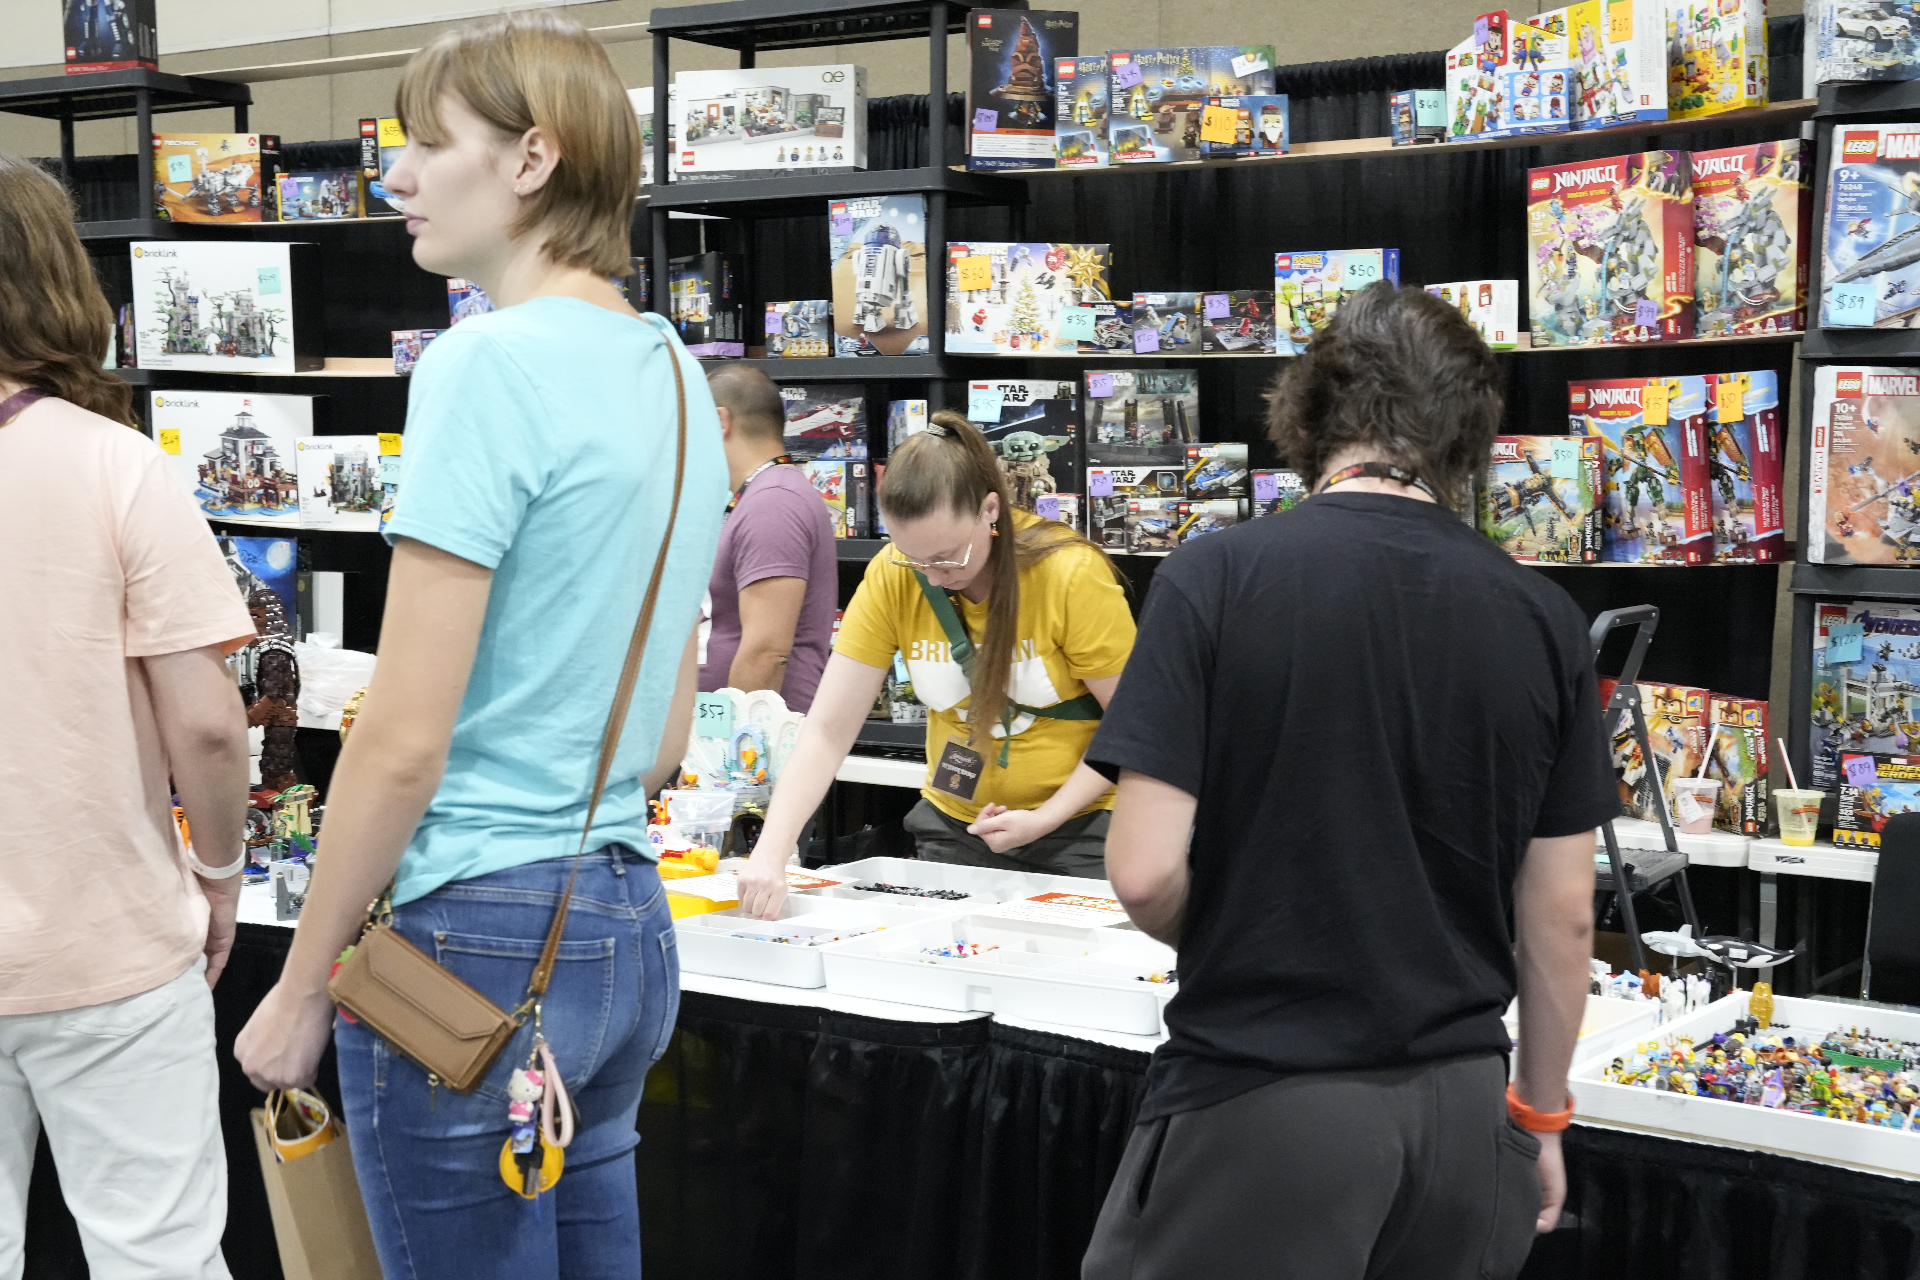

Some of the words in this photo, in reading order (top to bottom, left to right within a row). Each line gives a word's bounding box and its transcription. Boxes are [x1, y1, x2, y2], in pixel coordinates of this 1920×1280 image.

[1611, 17, 1630, 34] $60
[1134, 54, 1157, 67] Harry
[1157, 51, 1181, 66] Potter
[1078, 61, 1101, 74] Harry
[1418, 99, 1439, 109] $60
[1204, 115, 1232, 131] $110
[1842, 140, 1878, 154] LEGO
[1531, 178, 1550, 190] LEGO
[1552, 164, 1620, 194] NINJAGO
[1839, 169, 1860, 182] 9+
[851, 200, 882, 210] STAR
[1531, 211, 1547, 221] 13+
[144, 250, 178, 258] bricklink
[1293, 255, 1322, 264] SONIC
[961, 267, 985, 280] $50
[1348, 264, 1376, 277] $50
[1834, 293, 1865, 311] $89
[997, 385, 1029, 394] STAR
[1838, 379, 1861, 391] LEGO
[1868, 375, 1919, 396] MARVEL
[165, 400, 200, 408] bricklink
[1003, 394, 1029, 403] ARS
[1587, 388, 1643, 409] NINJAGO
[1834, 403, 1857, 413] 10+
[1571, 419, 1582, 430] 9+
[305, 443, 334, 451] bricklink
[1553, 449, 1573, 461] $50
[1277, 480, 1302, 488] ARS
[1853, 610, 1920, 637] AVENGERS
[699, 703, 724, 721] $57
[1848, 761, 1871, 777] $89
